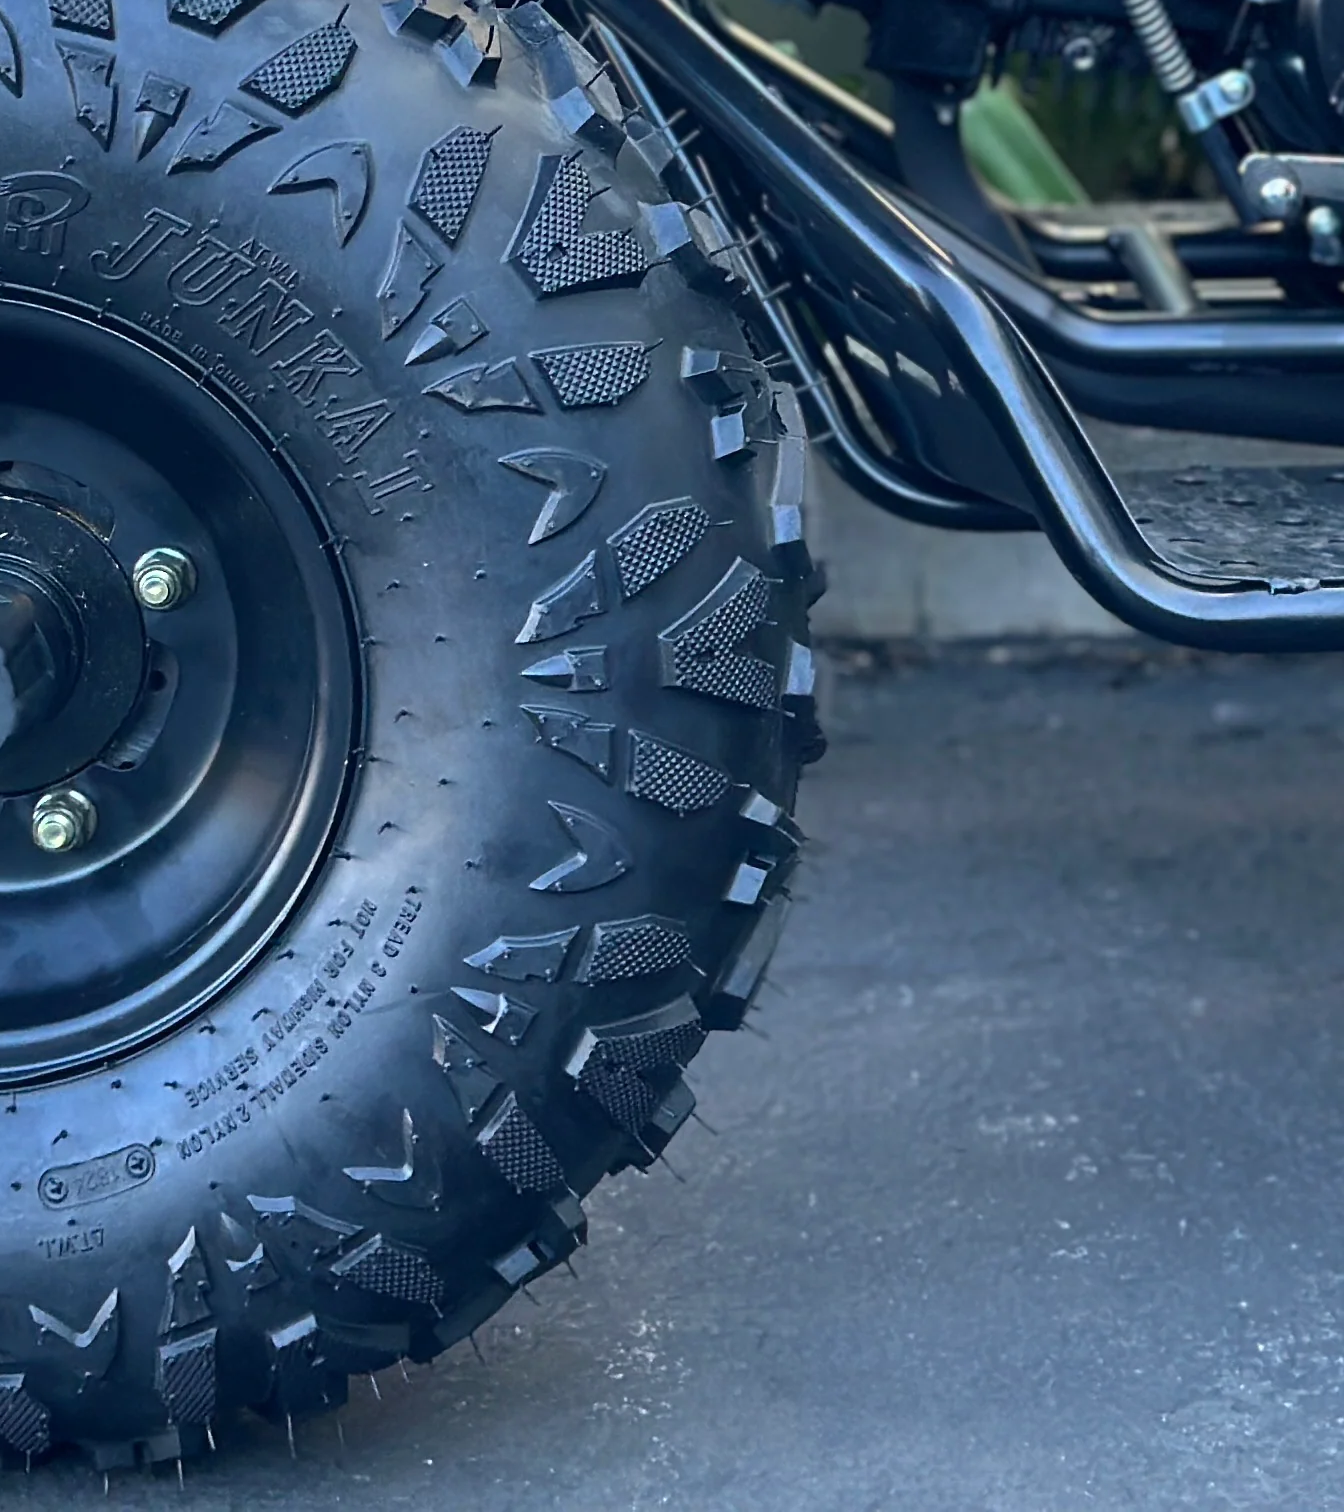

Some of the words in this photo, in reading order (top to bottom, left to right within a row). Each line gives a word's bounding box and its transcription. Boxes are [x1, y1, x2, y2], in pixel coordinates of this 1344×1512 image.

[88, 207, 434, 516] JUNKAI
[380, 897, 423, 958] TREAD
[322, 941, 353, 980] FOR
[184, 1047, 260, 1108] SERVICE
